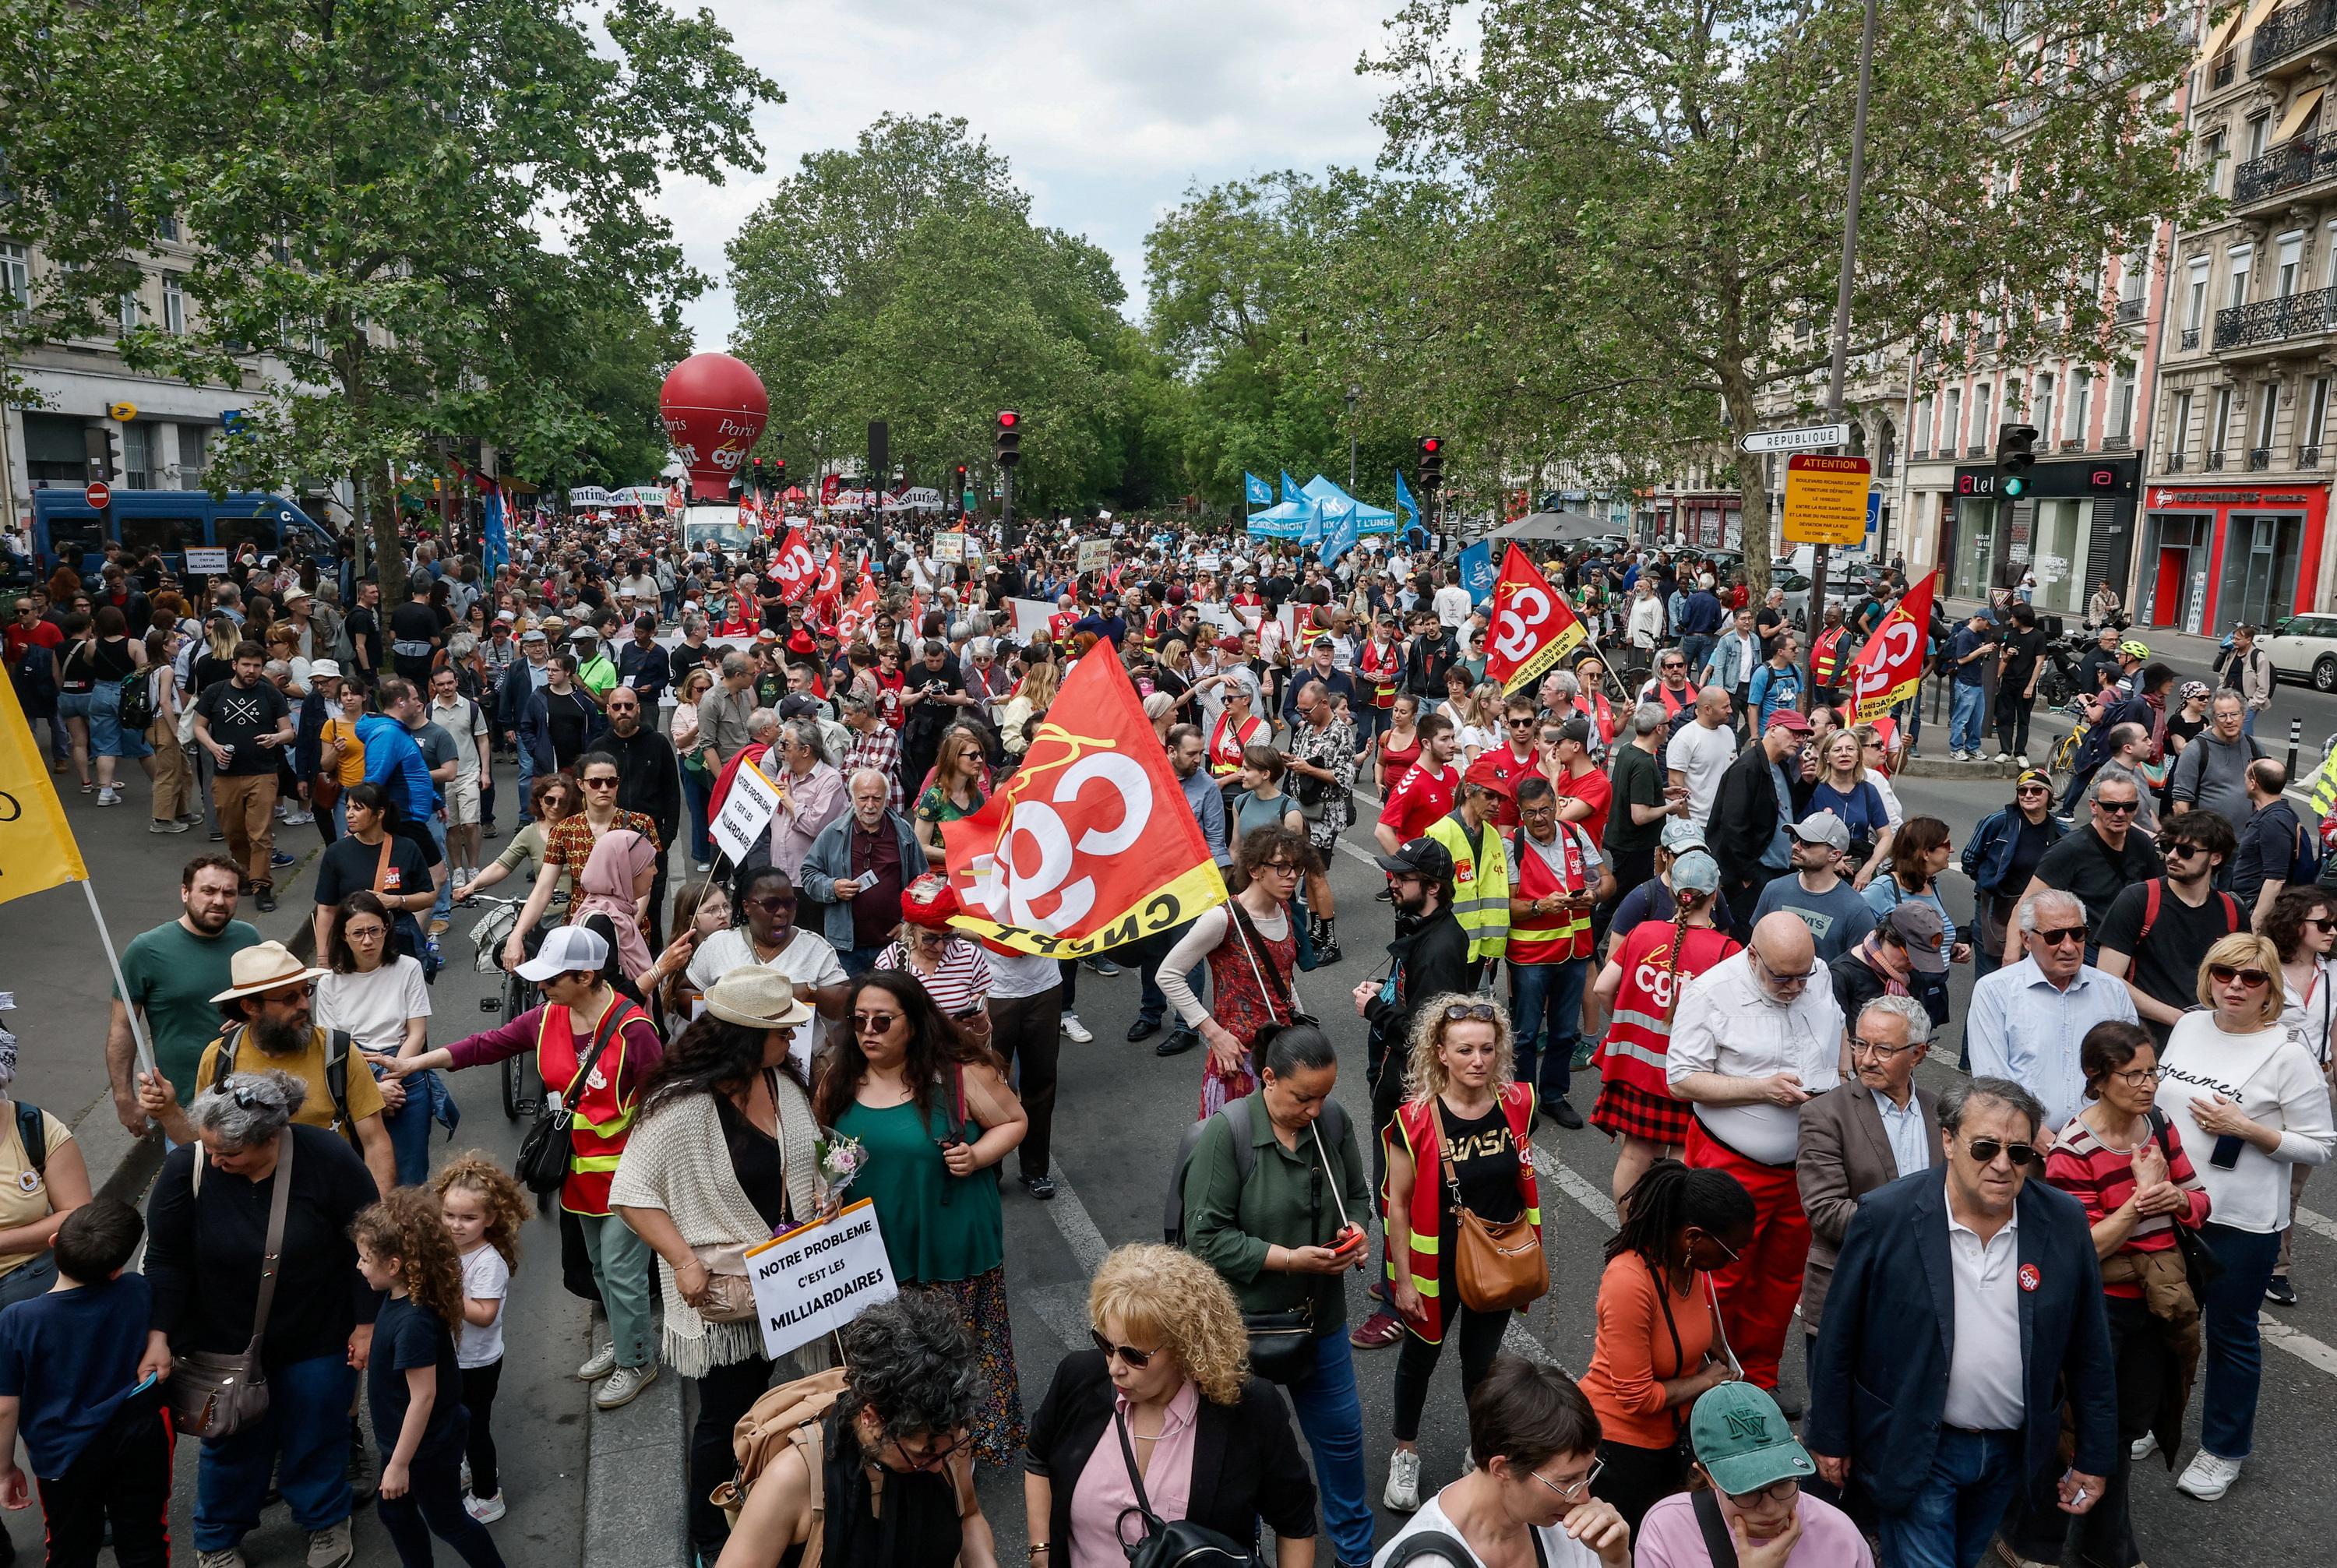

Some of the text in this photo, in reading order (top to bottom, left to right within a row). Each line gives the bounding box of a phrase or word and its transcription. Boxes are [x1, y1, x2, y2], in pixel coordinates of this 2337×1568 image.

[717, 418, 757, 437] Paris
[1768, 431, 1834, 446] RÉPUBLIQUE
[711, 449, 746, 470] cgt
[1803, 459, 1857, 469] ATTENTION
[1364, 518, 1394, 527] L'UNSA
[736, 773, 771, 815] NOTRE PROBLEME
[735, 801, 753, 822] C'EST LES
[1460, 869, 1473, 881] cgt
[1447, 1127, 1515, 1162] NASA
[759, 1220, 872, 1280] NOTRE PROBLEME
[798, 1259, 845, 1288] C'EST LES
[2021, 1270, 2038, 1290] cgt
[770, 1268, 884, 1331] MILLIARDAIRES
